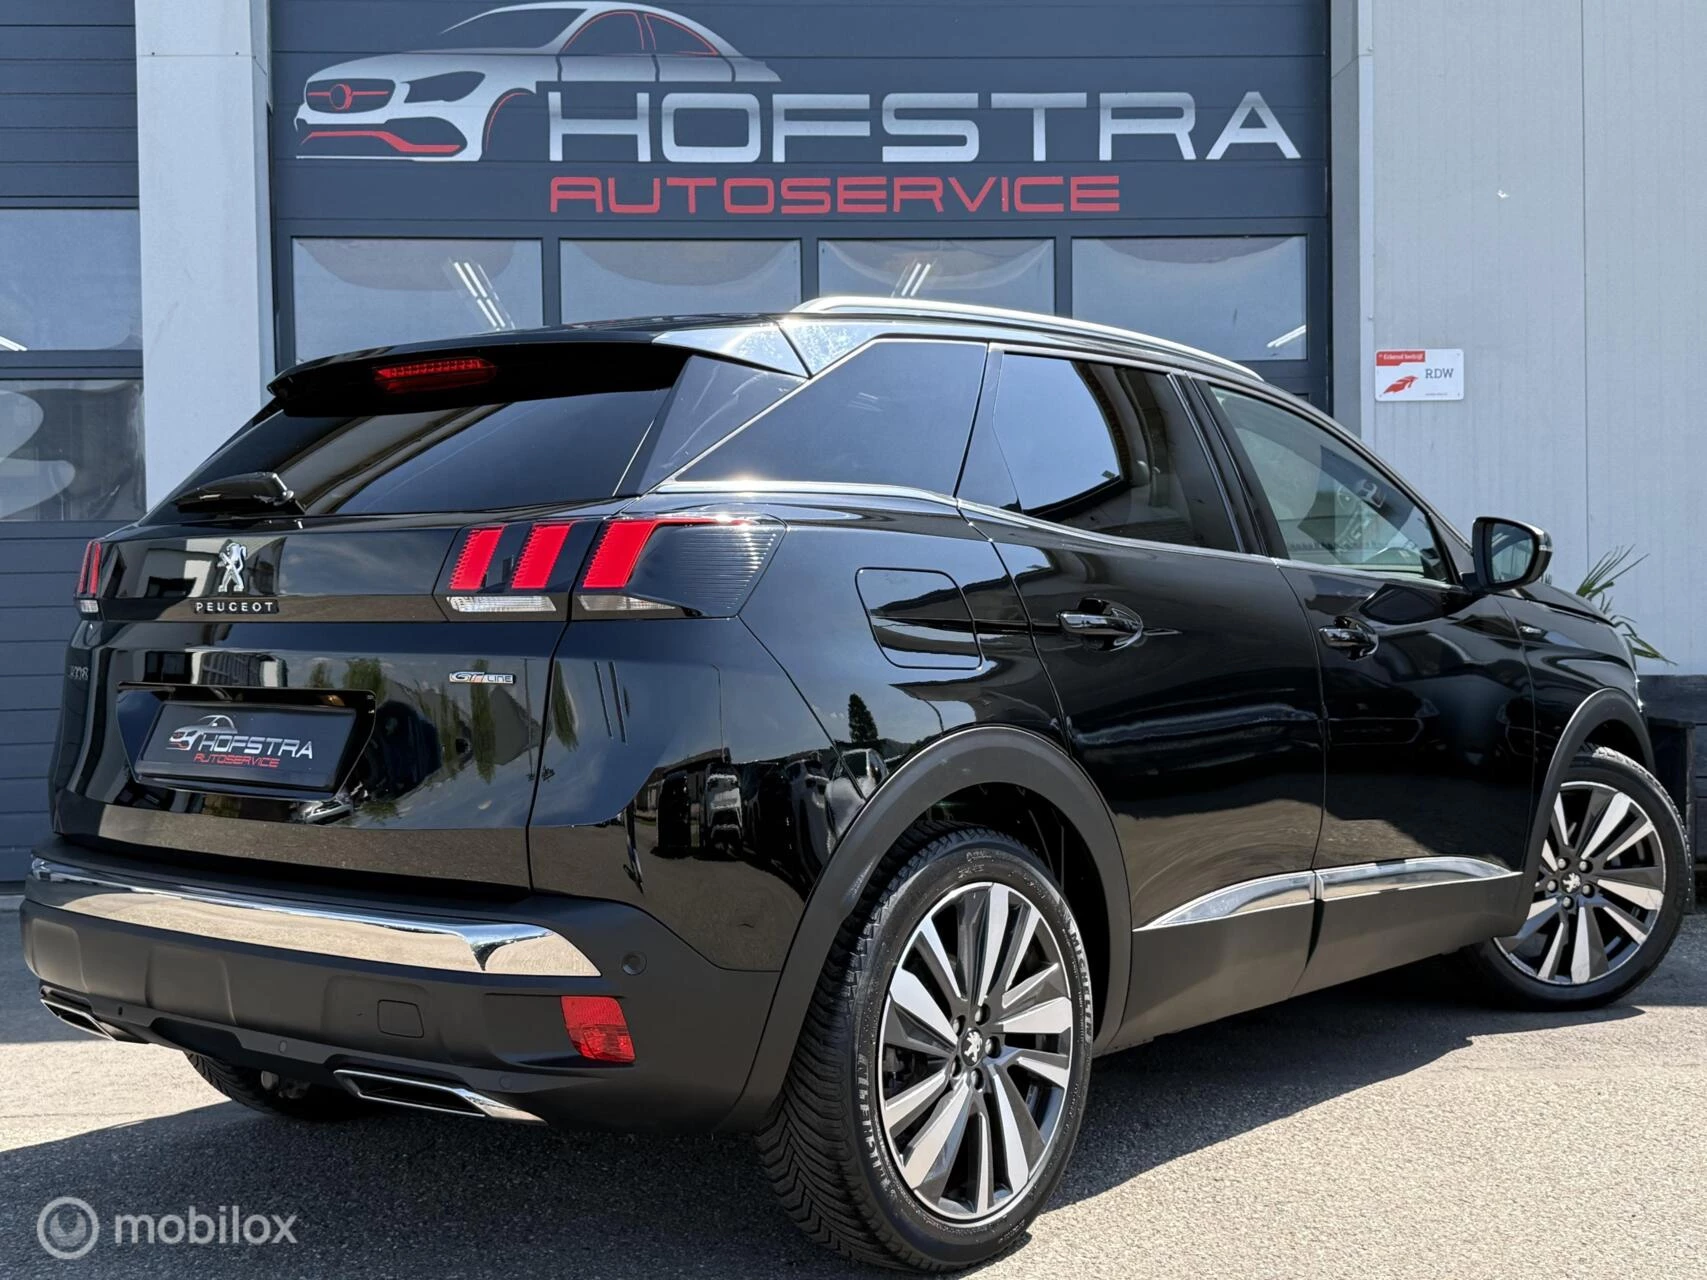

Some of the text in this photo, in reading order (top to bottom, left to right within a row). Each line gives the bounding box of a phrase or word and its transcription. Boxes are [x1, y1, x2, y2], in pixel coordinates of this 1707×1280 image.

[549, 91, 1302, 163] HOFSTRA
[550, 175, 1120, 214] AUTOSERVICE
[1425, 368, 1454, 379] RDW
[195, 602, 273, 612] PEUGEOT
[198, 733, 314, 760] HOFSTRA
[193, 752, 281, 769] AUTOSERVICE
[1069, 932, 1093, 1038] MICHELIN
